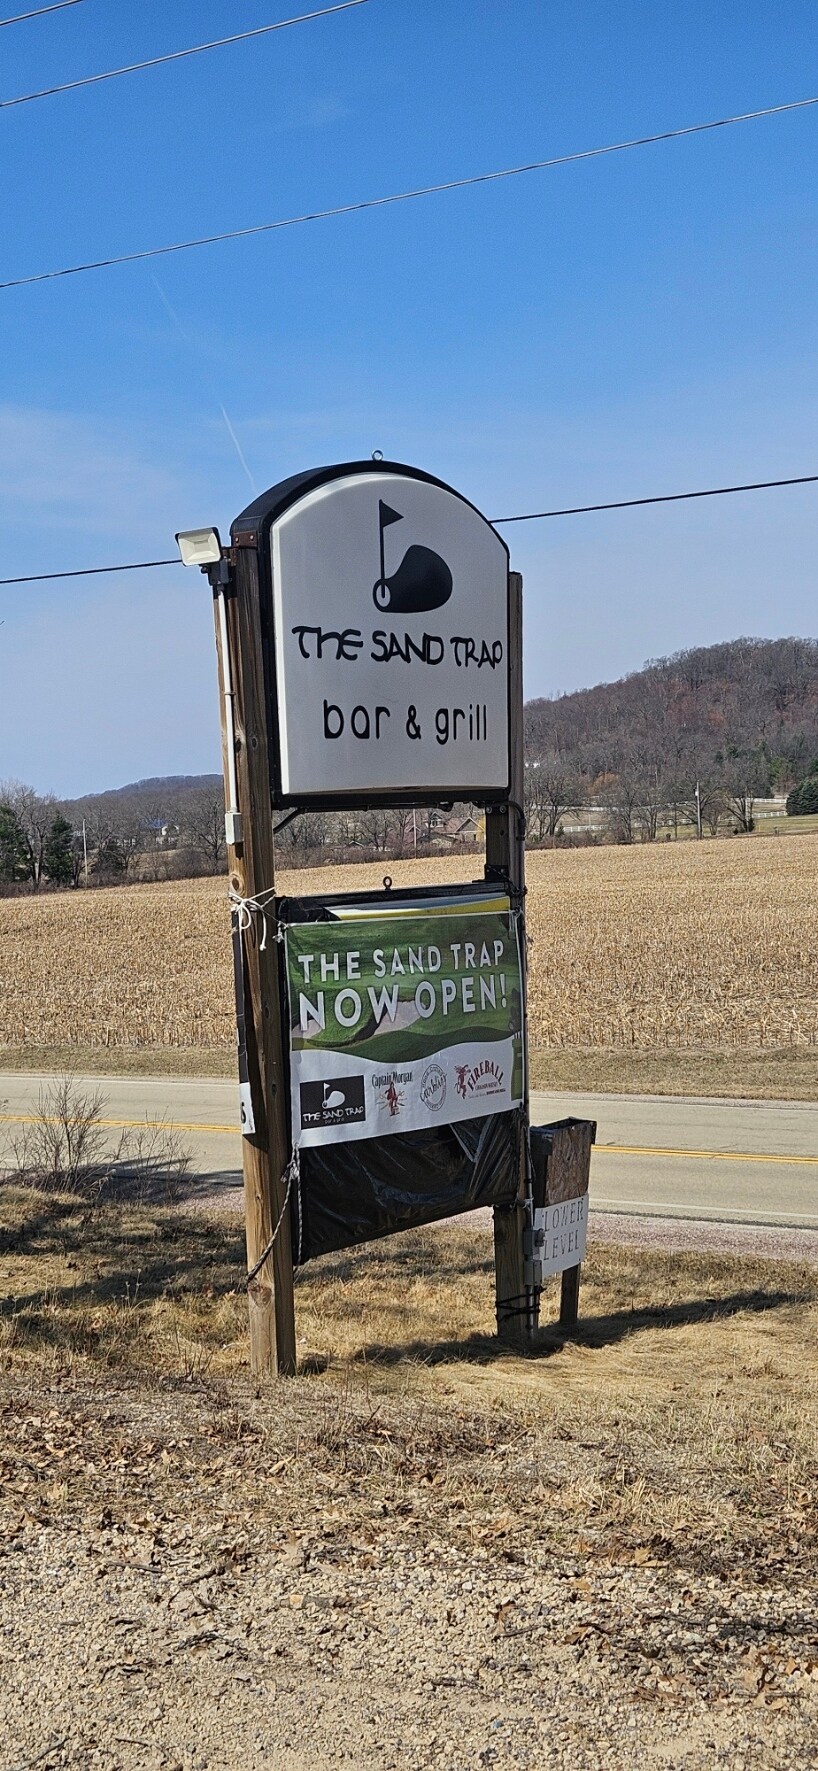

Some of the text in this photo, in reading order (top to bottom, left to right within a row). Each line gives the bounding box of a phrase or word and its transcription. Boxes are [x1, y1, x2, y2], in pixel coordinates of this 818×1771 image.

[371, 630, 444, 665] SAND
[450, 637, 503, 669] TRAP
[323, 699, 486, 745] bar & grill
[298, 940, 503, 983] THE SAND TRAP
[299, 974, 507, 1031] NOW OPEN!
[371, 1072, 392, 1089] Captain
[391, 1071, 413, 1085] Morgan
[467, 1059, 504, 1092] FIREBALL
[322, 1109, 344, 1119] SAND
[344, 1105, 364, 1116] TRAP
[544, 1200, 584, 1232] LOWER
[543, 1229, 580, 1260] LEVEL
